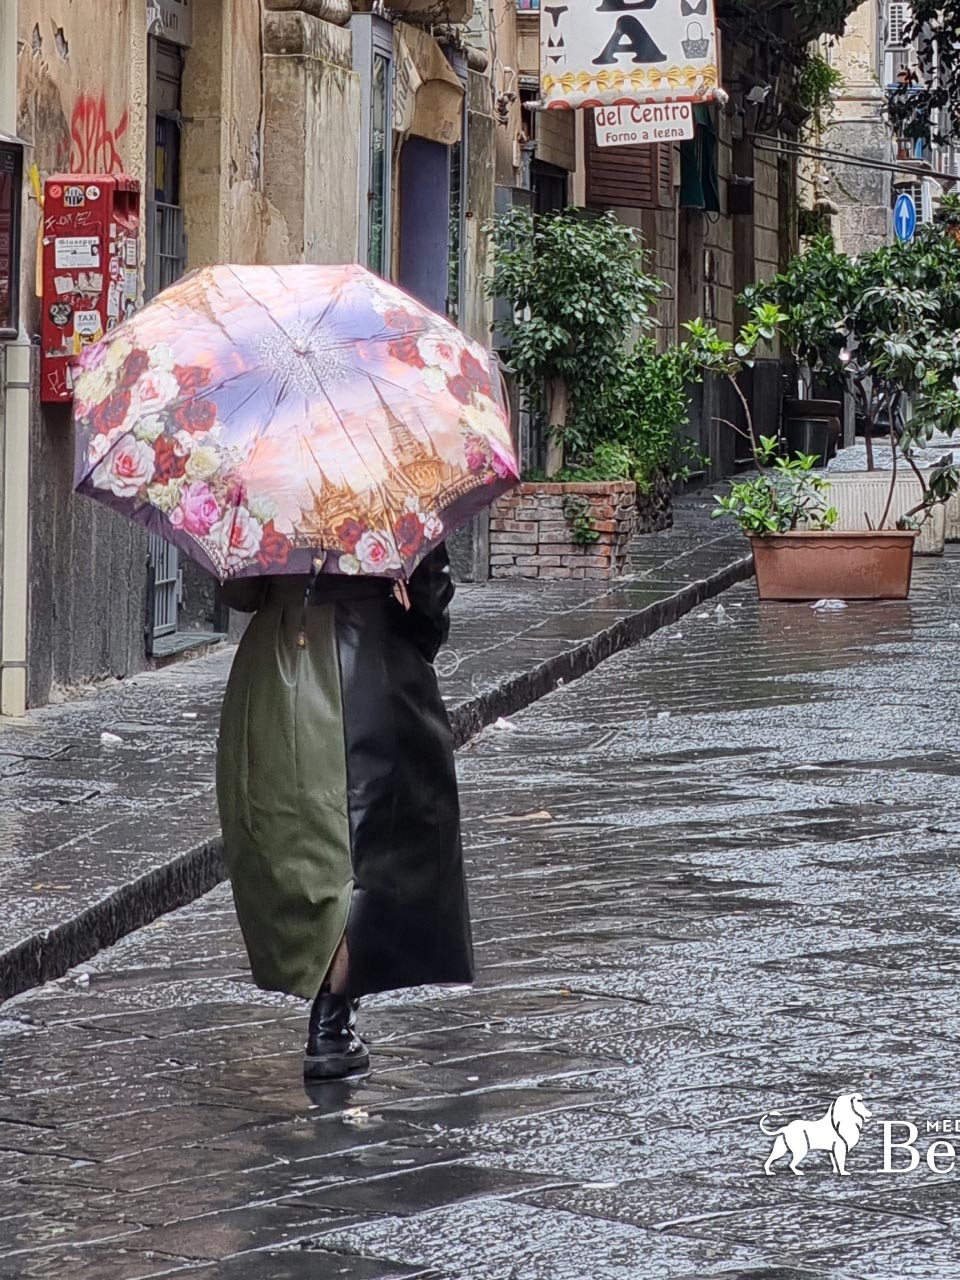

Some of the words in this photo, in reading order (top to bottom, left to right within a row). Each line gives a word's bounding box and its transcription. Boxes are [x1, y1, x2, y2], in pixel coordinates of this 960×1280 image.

[596, 106, 622, 126] del
[630, 104, 689, 123] Centro
[606, 132, 637, 142] Forno
[642, 131, 649, 140] a
[654, 128, 684, 138] legna
